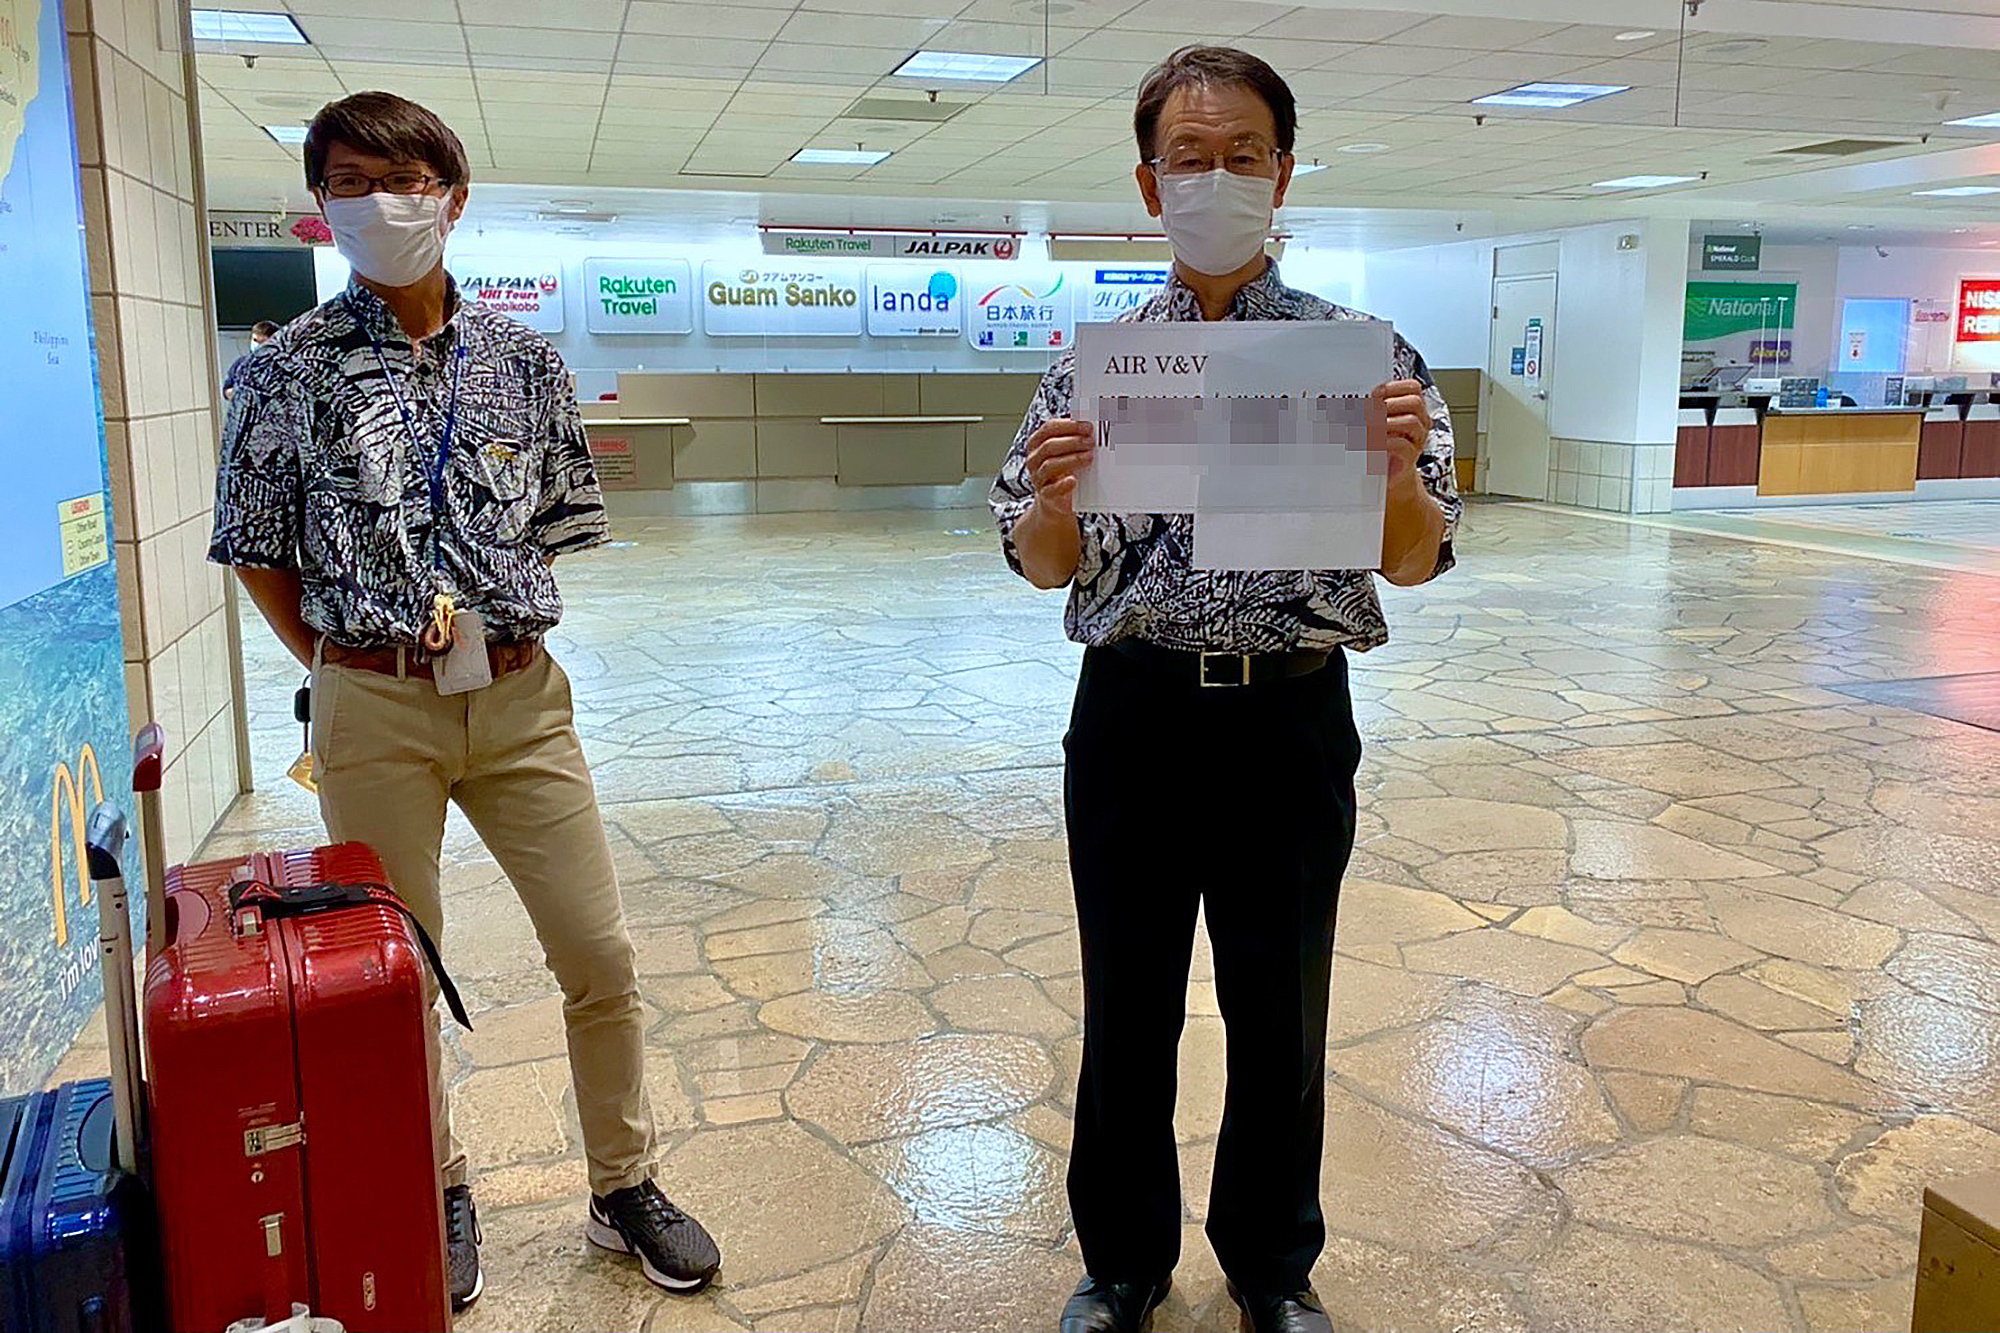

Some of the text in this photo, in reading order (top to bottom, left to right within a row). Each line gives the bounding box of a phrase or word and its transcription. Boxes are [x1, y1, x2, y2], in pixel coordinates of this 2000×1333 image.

[785, 237, 871, 252] Rakuten Travel
[904, 241, 989, 255] JALPAK
[461, 276, 538, 289] JALPAK
[599, 275, 677, 294] Rakuten
[505, 290, 539, 300] Tours
[708, 281, 857, 307] Guam Sanko
[601, 297, 657, 315] Travel
[986, 304, 1054, 321] 日本旅行
[1707, 299, 1778, 317] National
[1104, 355, 1209, 374] AIR V&V
